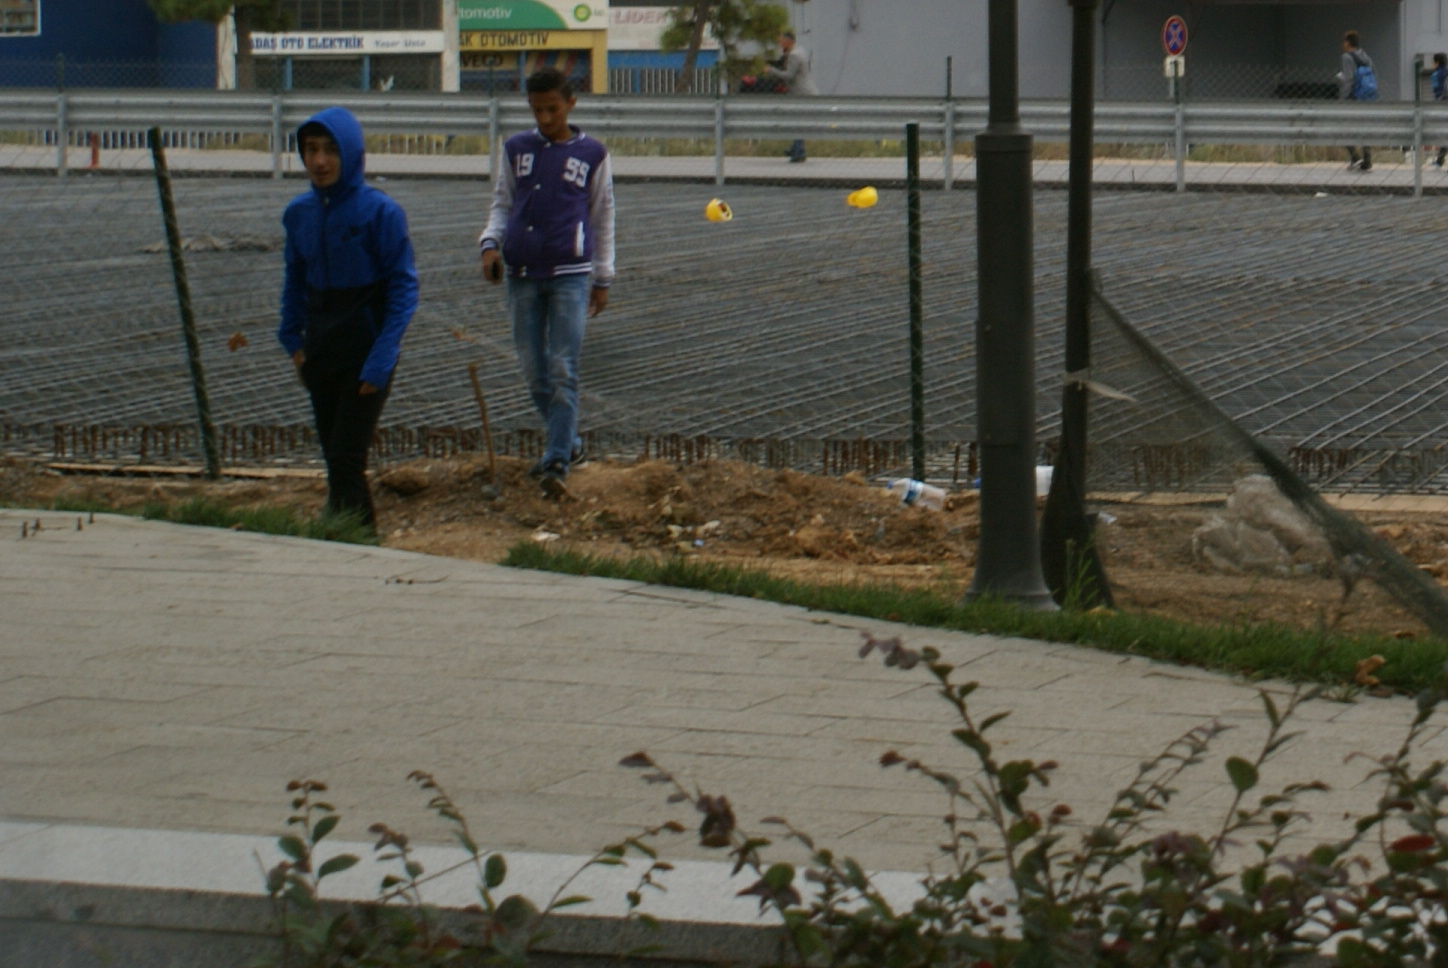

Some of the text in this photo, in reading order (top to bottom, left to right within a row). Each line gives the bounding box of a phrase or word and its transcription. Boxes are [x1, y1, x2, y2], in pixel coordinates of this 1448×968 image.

[281, 36, 305, 50] OTO
[307, 34, 365, 51] ELEKTRİK
[515, 153, 535, 178] 19
